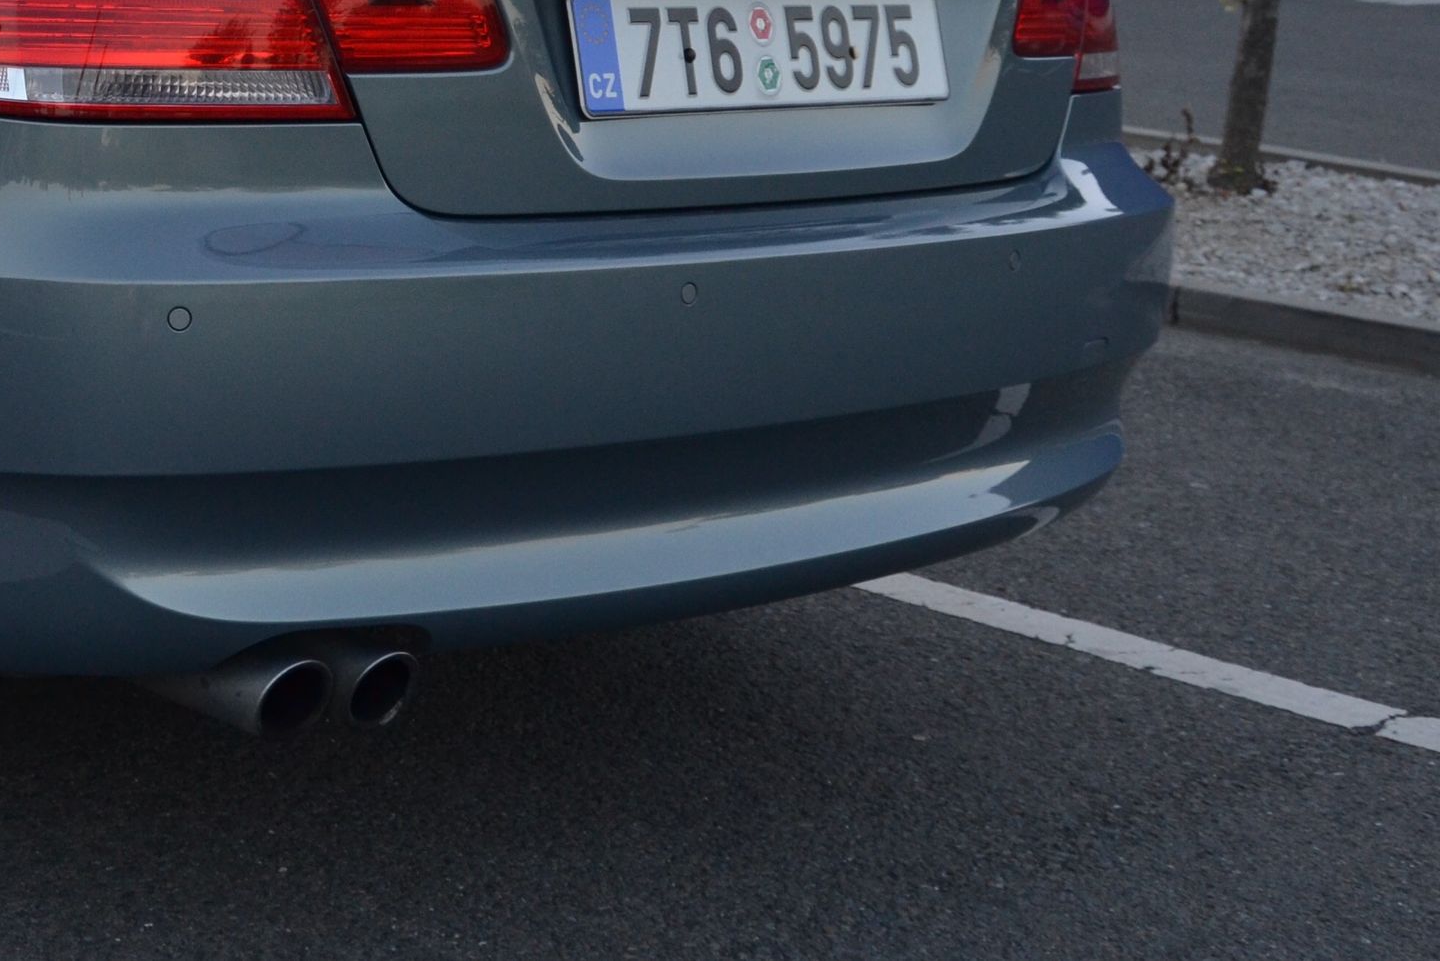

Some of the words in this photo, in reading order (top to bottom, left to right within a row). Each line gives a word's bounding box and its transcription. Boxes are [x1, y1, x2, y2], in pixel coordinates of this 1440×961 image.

[628, 6, 744, 99] 7T6
[783, 4, 919, 90] 5975
[588, 73, 617, 99] CZ
